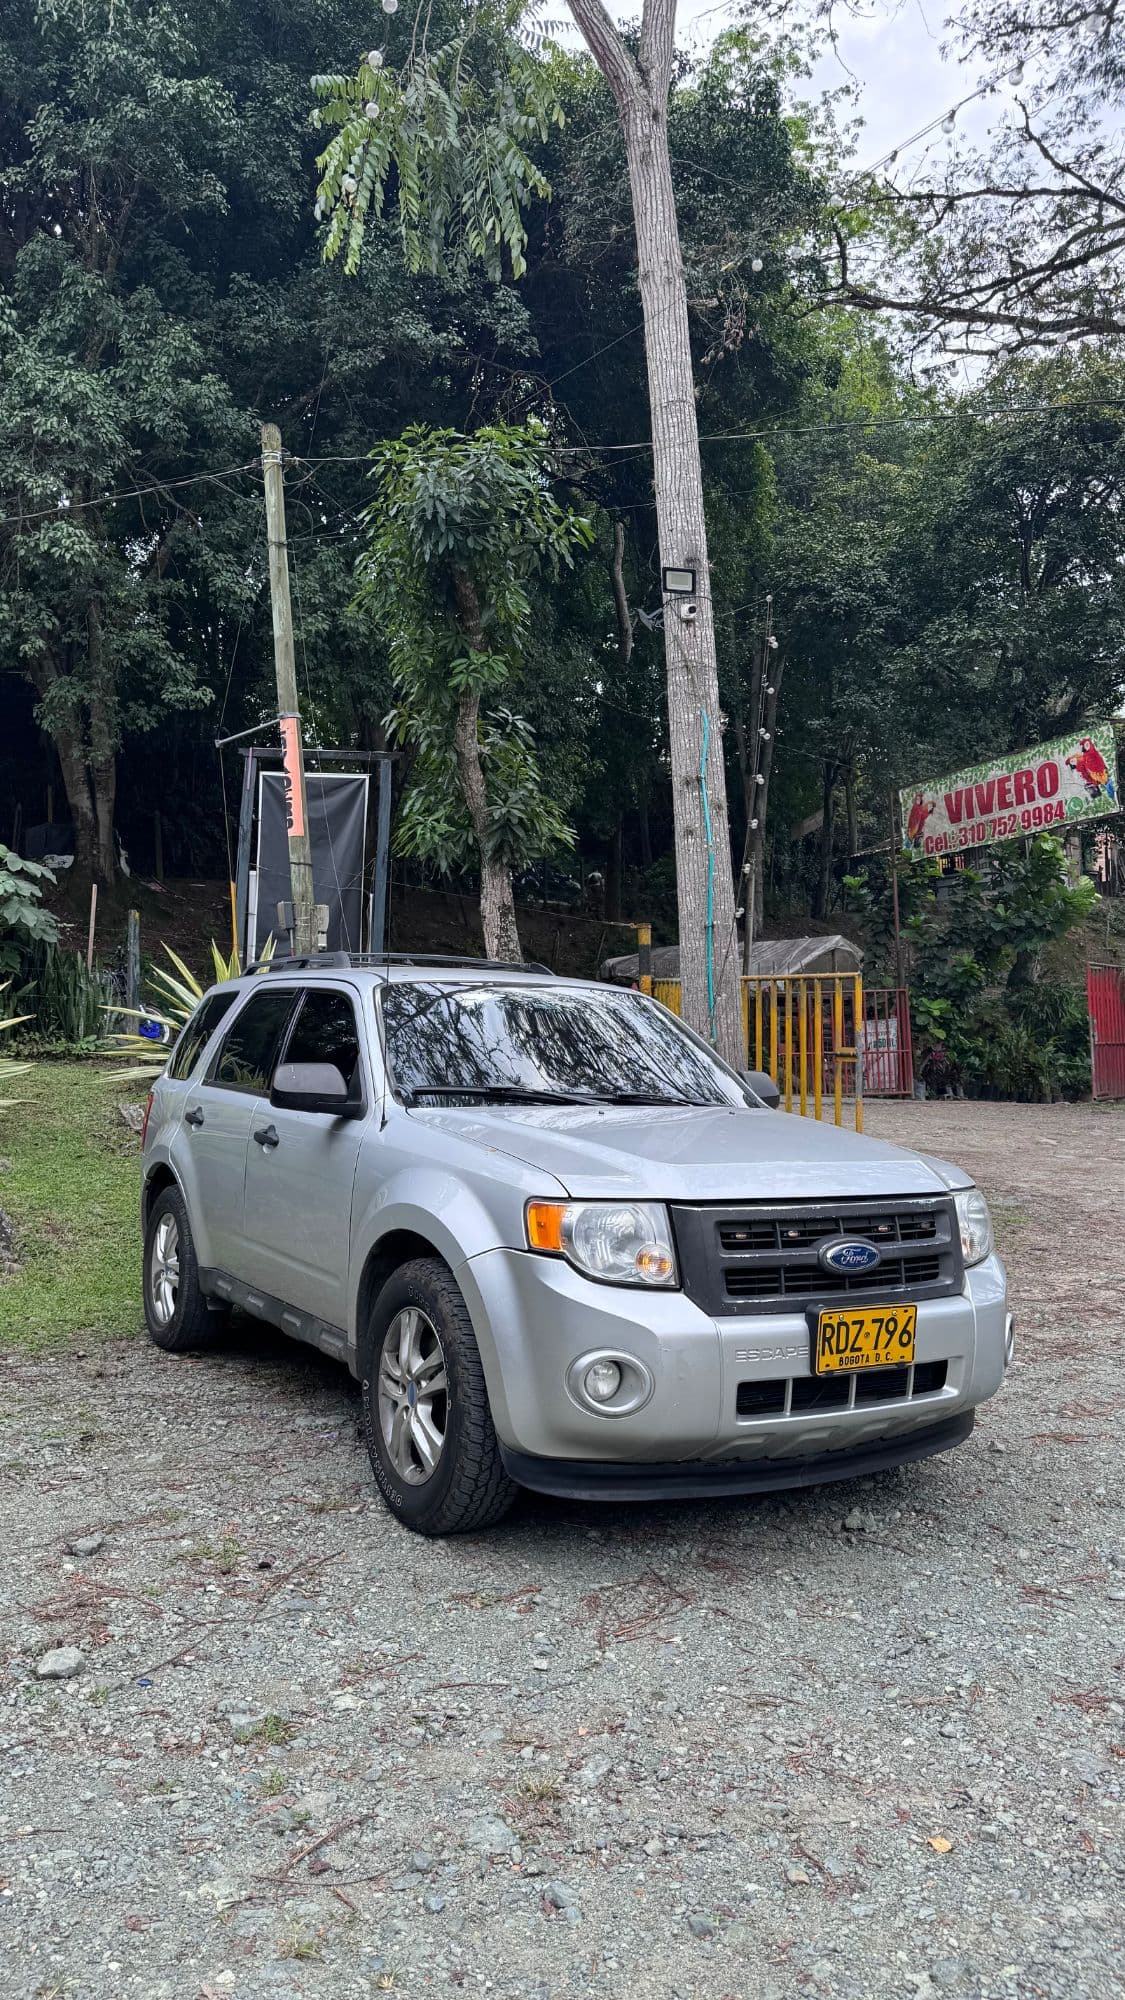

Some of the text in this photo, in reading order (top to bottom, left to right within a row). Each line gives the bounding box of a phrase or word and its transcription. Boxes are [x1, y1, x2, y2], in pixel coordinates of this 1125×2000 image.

[944, 762, 1059, 824] VIVERO
[959, 822, 986, 846] 310
[990, 814, 1017, 838] 752
[1021, 800, 1066, 830] 9984
[841, 1248, 869, 1265] Ford
[735, 1345, 809, 1362] ESCAPE
[839, 1354, 870, 1367] BOGOTA
